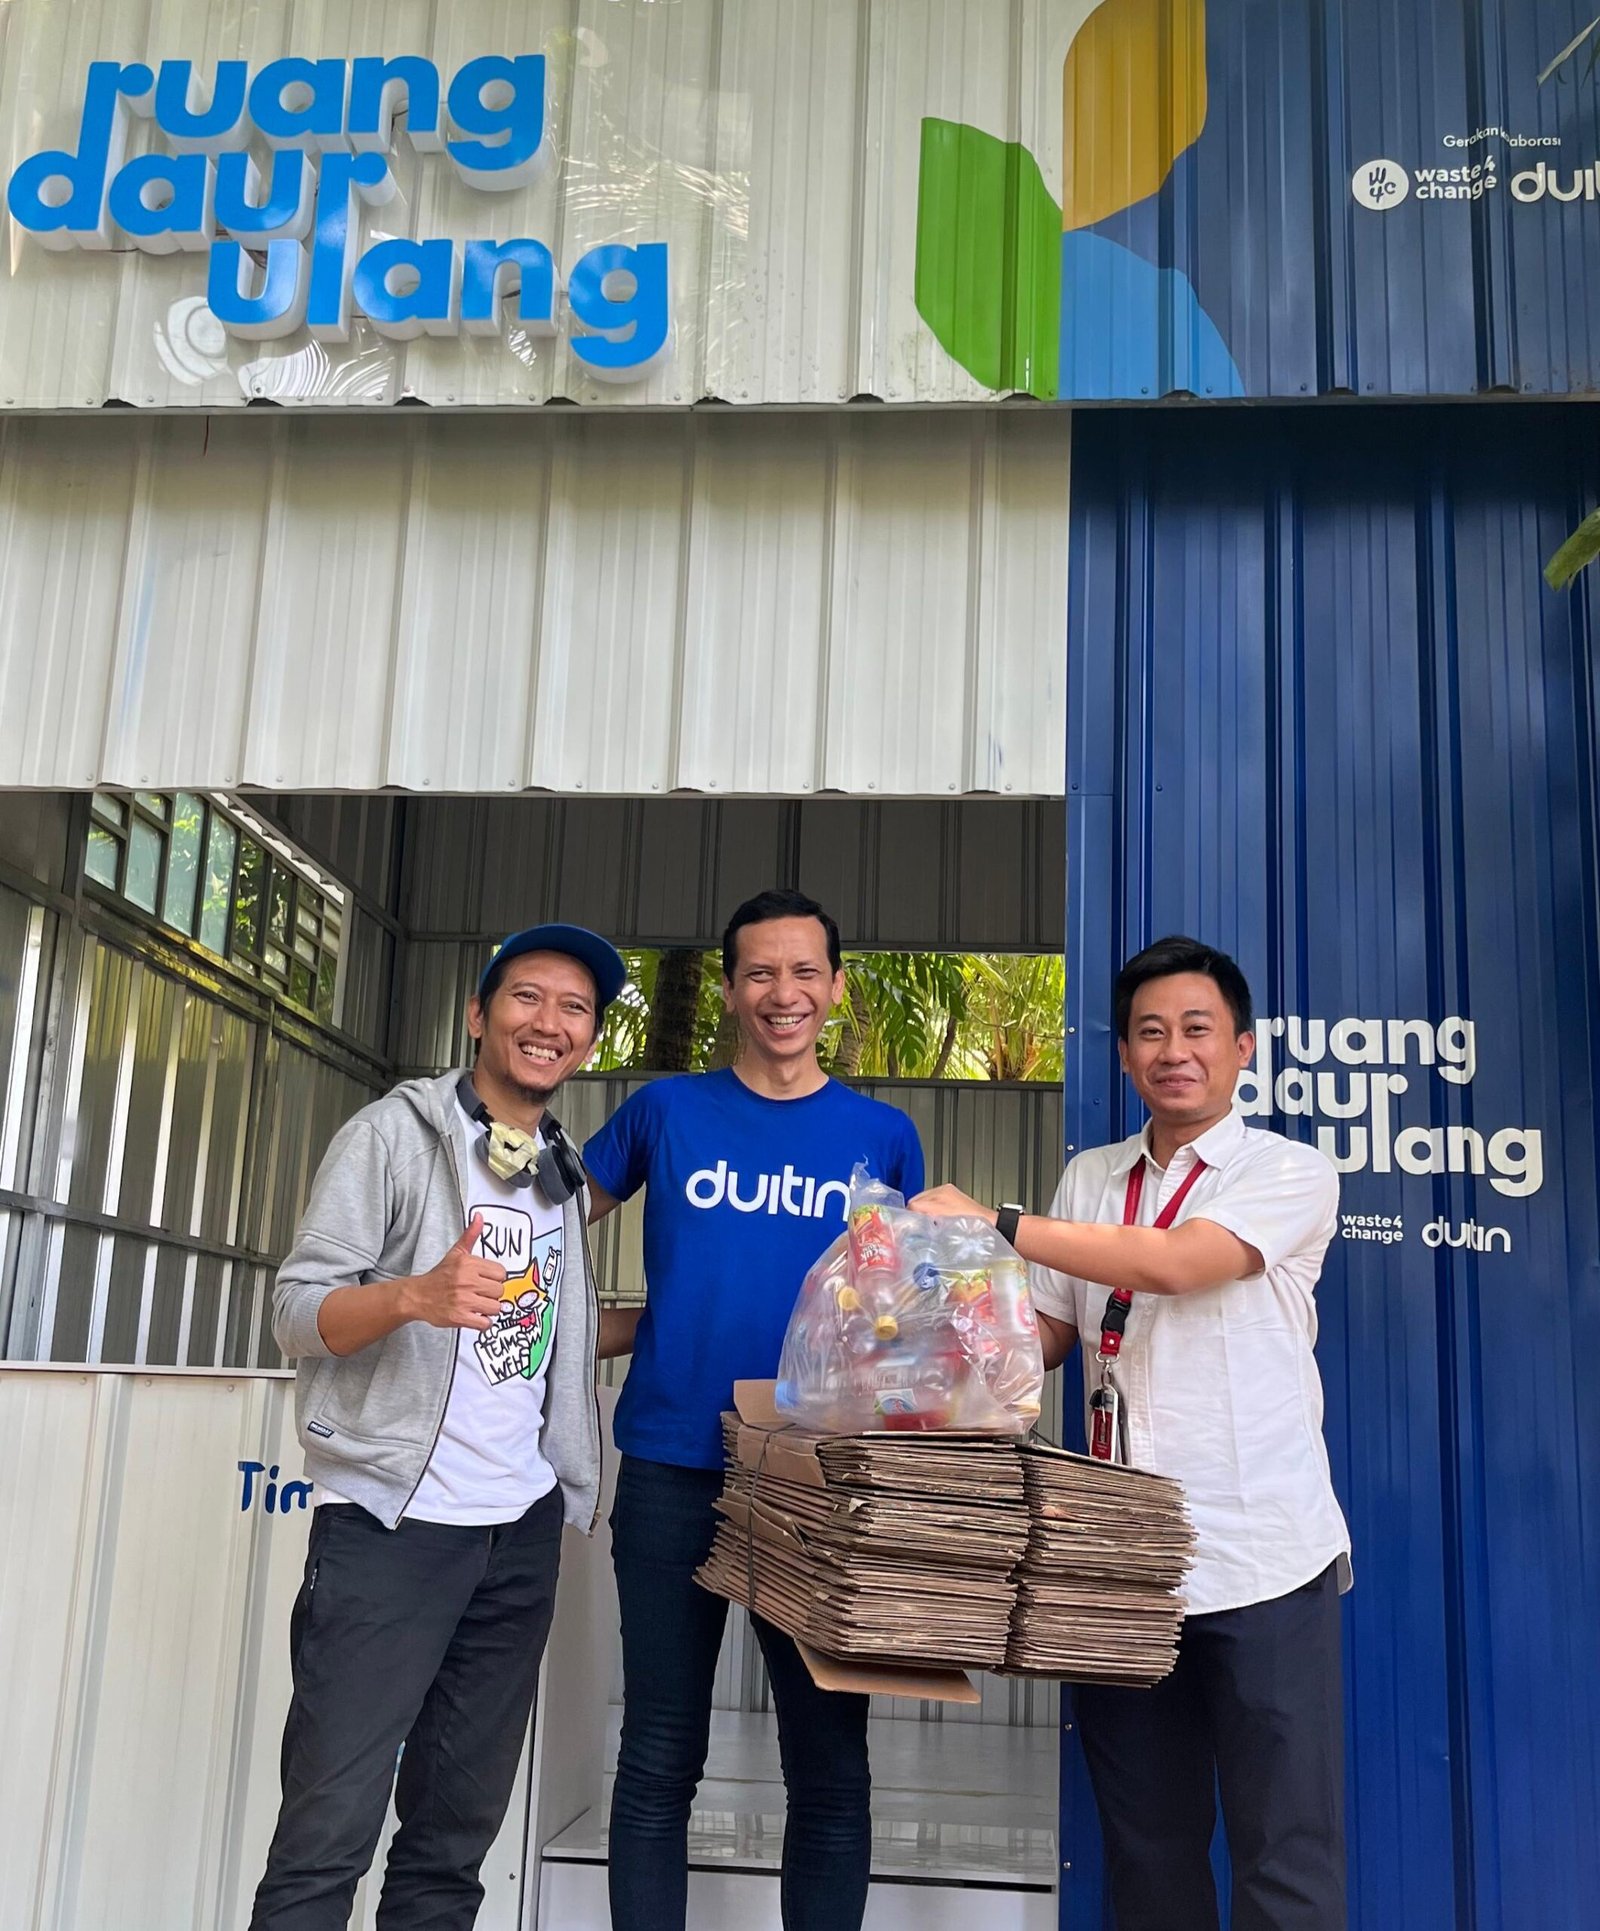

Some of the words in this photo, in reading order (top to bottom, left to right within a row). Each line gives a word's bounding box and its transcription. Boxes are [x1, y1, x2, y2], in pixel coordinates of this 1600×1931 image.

[82, 55, 545, 171] ruang
[1443, 127, 1499, 147] Gerakan
[1500, 126, 1561, 147] koaborasi
[8, 125, 388, 238] daur
[1415, 173, 1497, 200] change
[207, 224, 668, 368] ulang
[1256, 1016, 1476, 1084] ruang
[1232, 1055, 1408, 1118] daur
[1318, 1114, 1543, 1197] ulang
[686, 1160, 850, 1222] duitin
[1341, 1215, 1402, 1229] waste4
[480, 1221, 522, 1259] RUN
[1341, 1226, 1403, 1245] change
[1422, 1215, 1511, 1252] duitin
